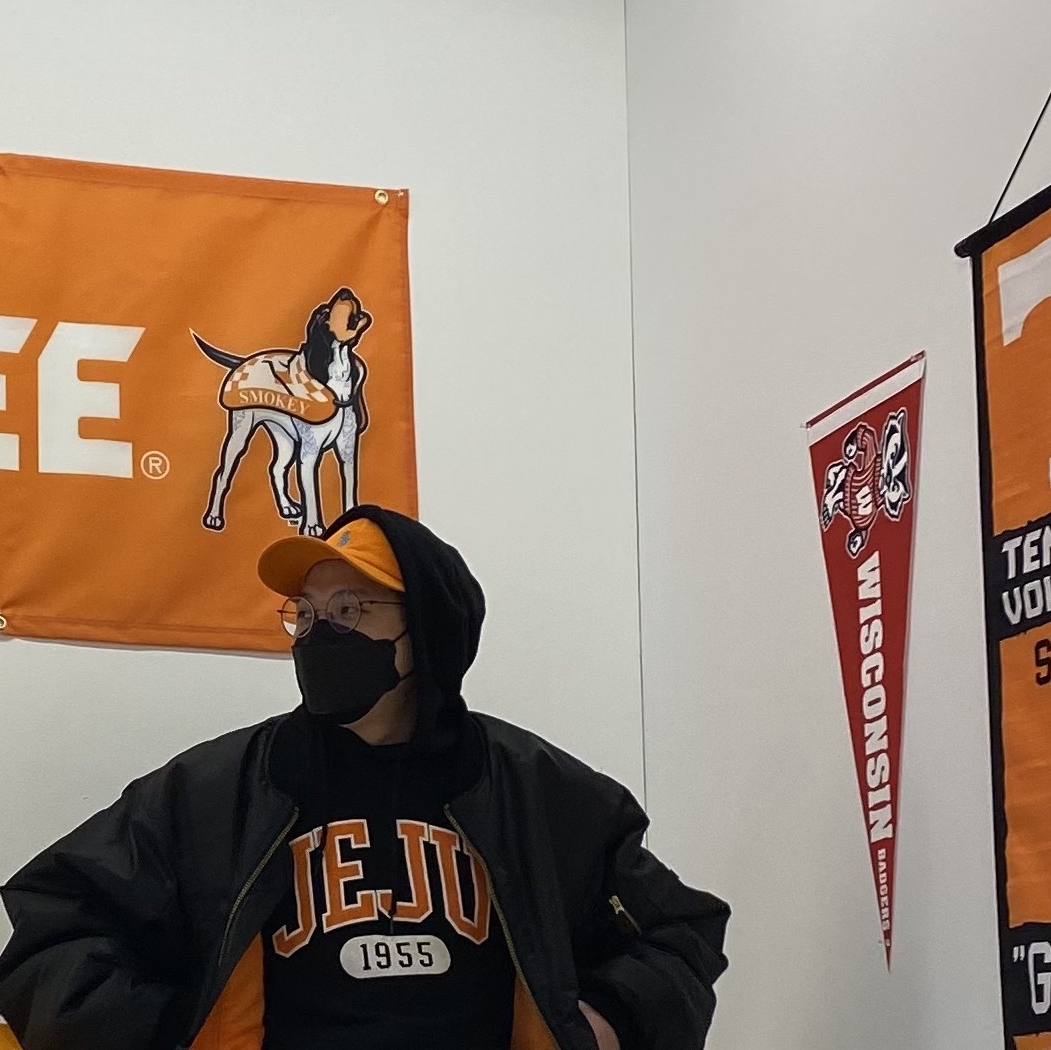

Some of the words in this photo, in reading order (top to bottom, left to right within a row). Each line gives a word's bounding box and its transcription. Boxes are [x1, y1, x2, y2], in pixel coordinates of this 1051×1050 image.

[239, 389, 310, 415] SMOKEY
[857, 550, 893, 843] WISCONSIN
[272, 818, 492, 959] JEJU
[877, 848, 891, 932] BADGERS
[359, 941, 434, 971] 1955
